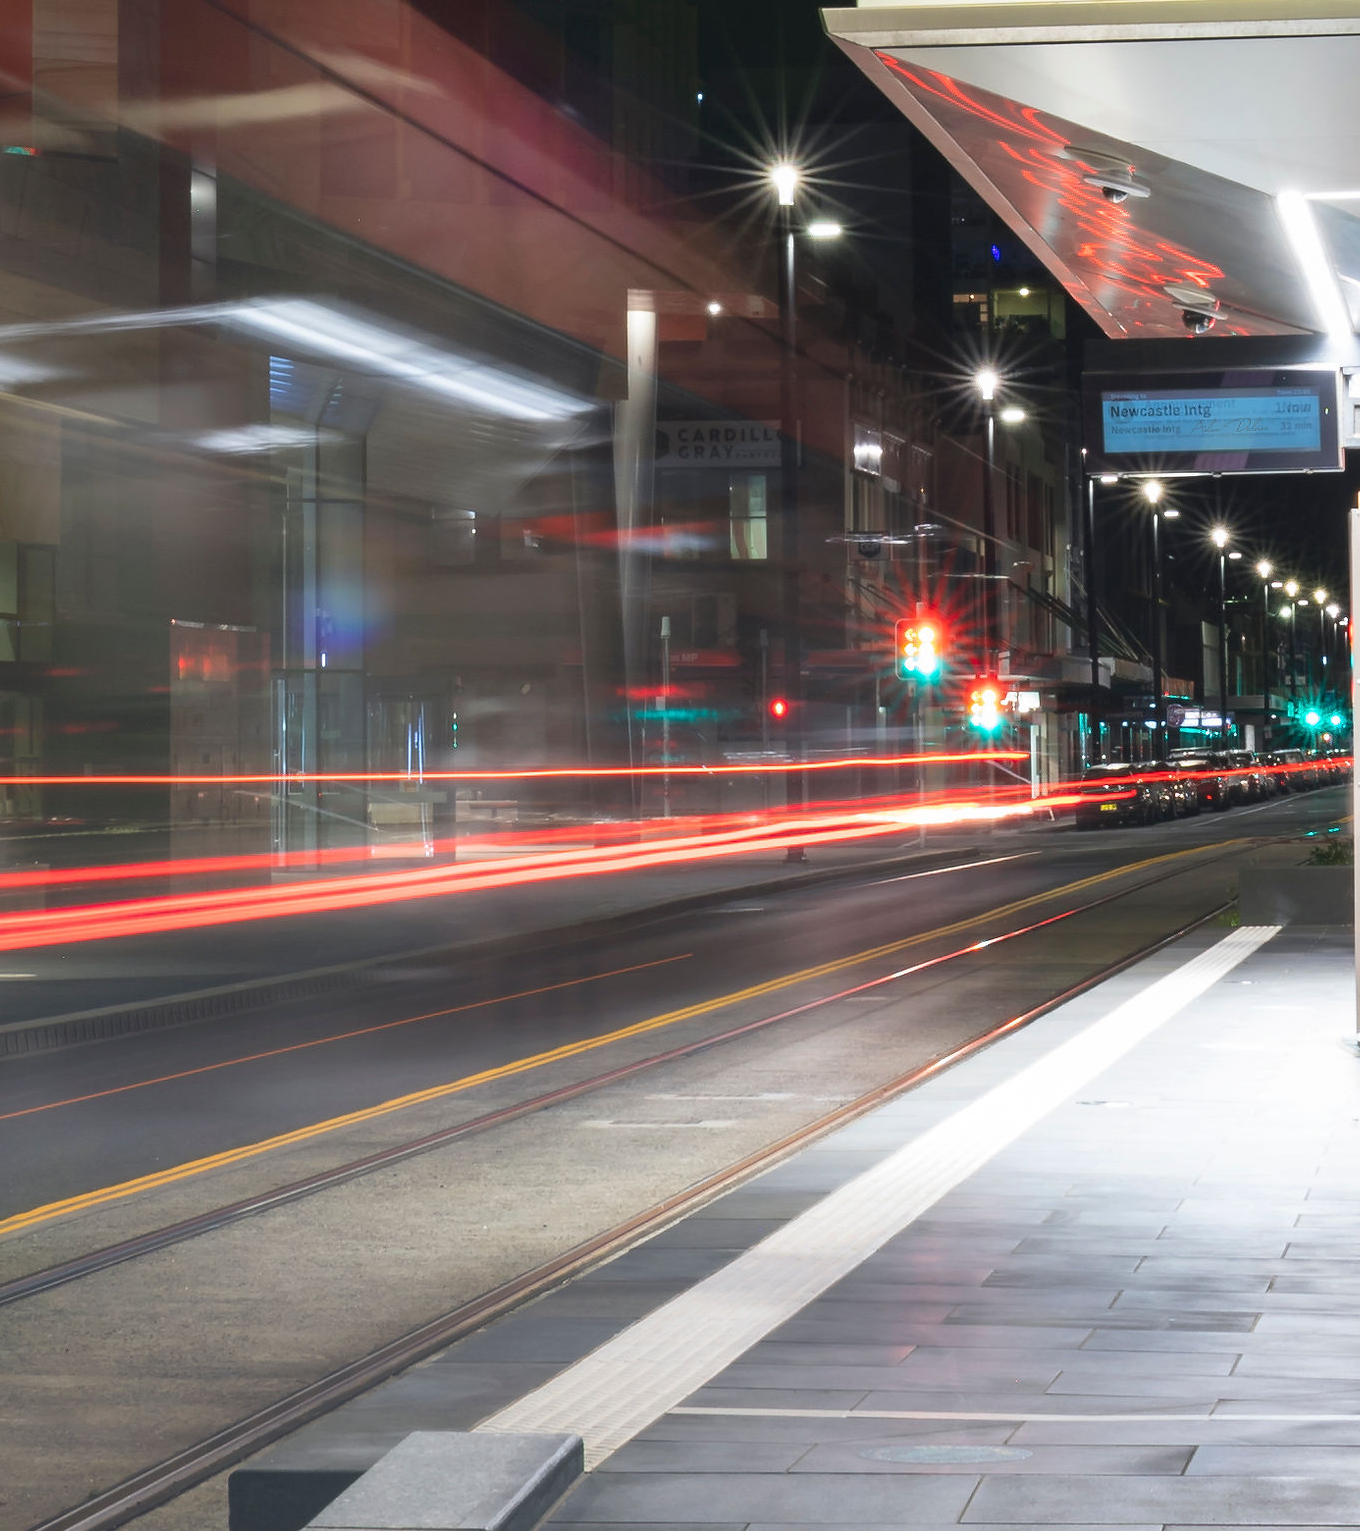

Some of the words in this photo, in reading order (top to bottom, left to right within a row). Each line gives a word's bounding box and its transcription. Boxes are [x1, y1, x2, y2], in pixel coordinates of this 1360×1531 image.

[1110, 403, 1180, 418] Newcastle
[1185, 403, 1212, 418] Intg
[1111, 424, 1160, 435] Newcastle
[1295, 421, 1312, 431] min
[678, 445, 735, 459] GRAY
